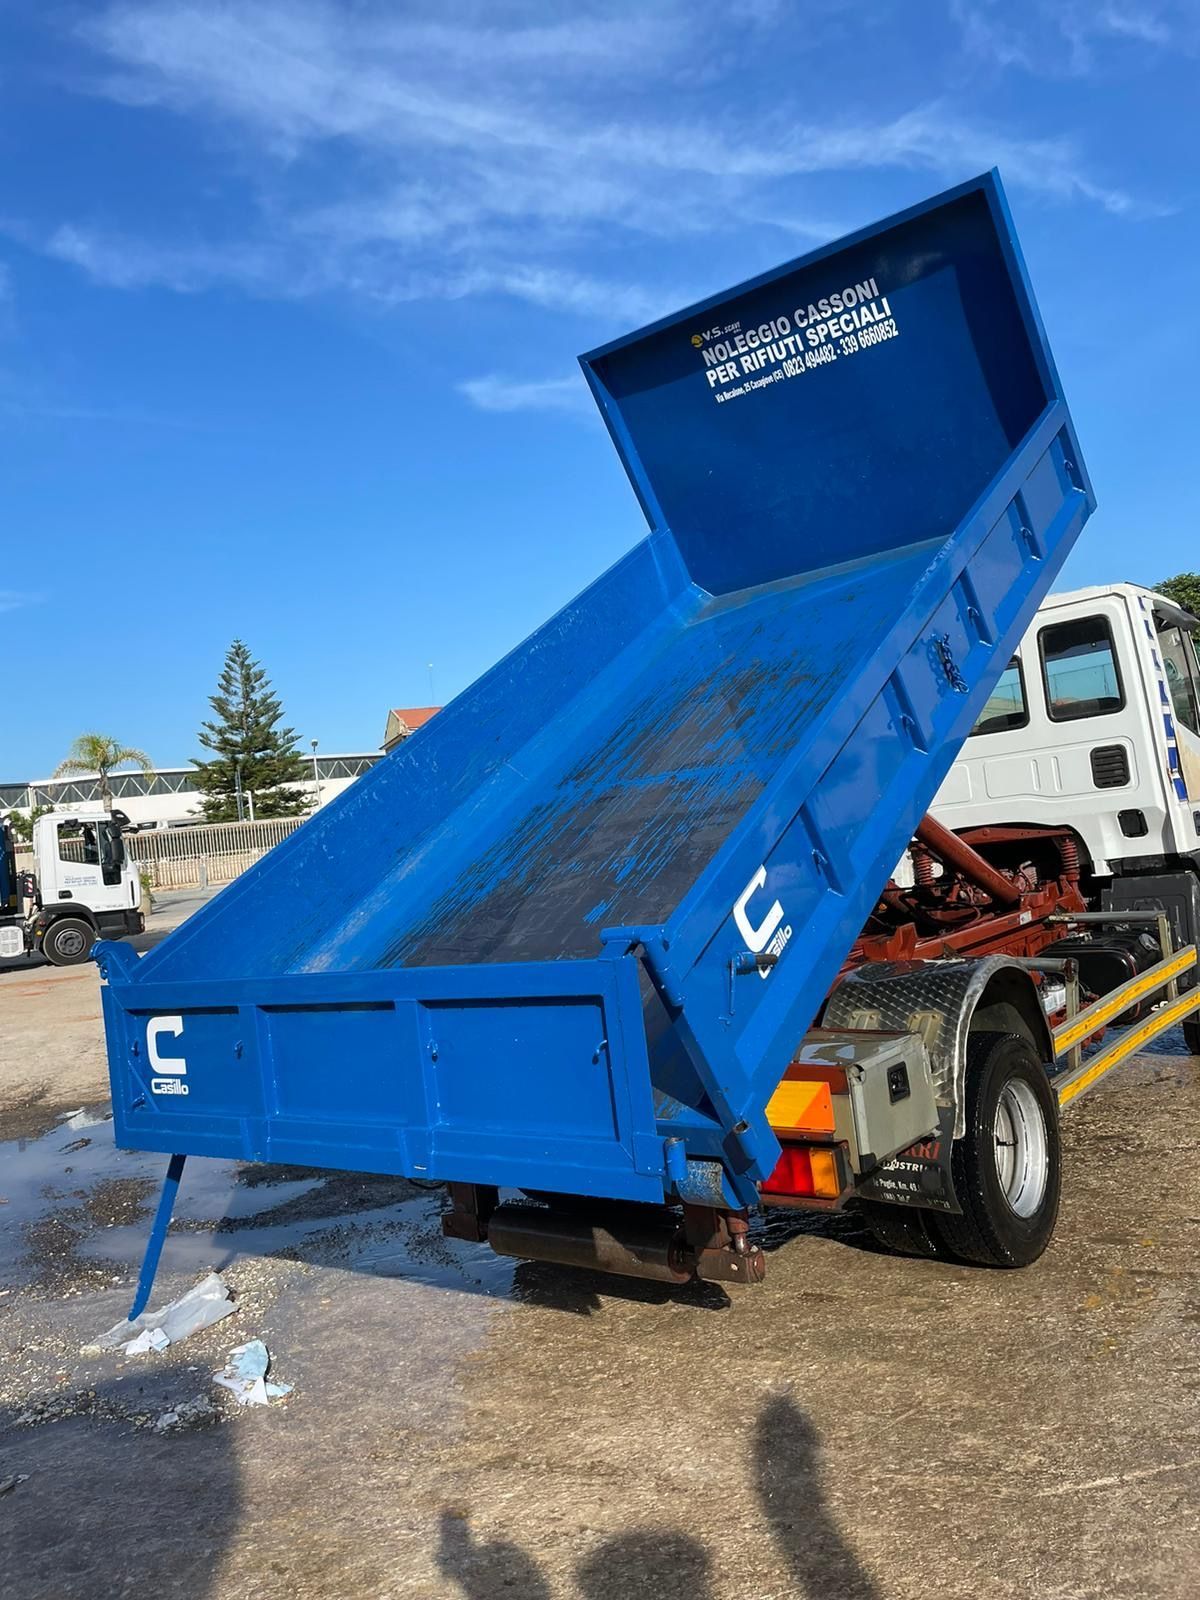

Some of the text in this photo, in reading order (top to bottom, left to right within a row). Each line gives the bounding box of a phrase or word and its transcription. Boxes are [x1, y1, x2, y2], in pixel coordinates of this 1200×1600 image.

[702, 277, 880, 367] NOLEGGIO CASSONI
[705, 297, 892, 388] PER RIFIUTI SPECIALI
[783, 355, 806, 378] 0823
[805, 343, 837, 369] 494482
[840, 335, 859, 356] 339
[858, 318, 899, 349] 6660852
[151, 1078, 189, 1095] Casillo
